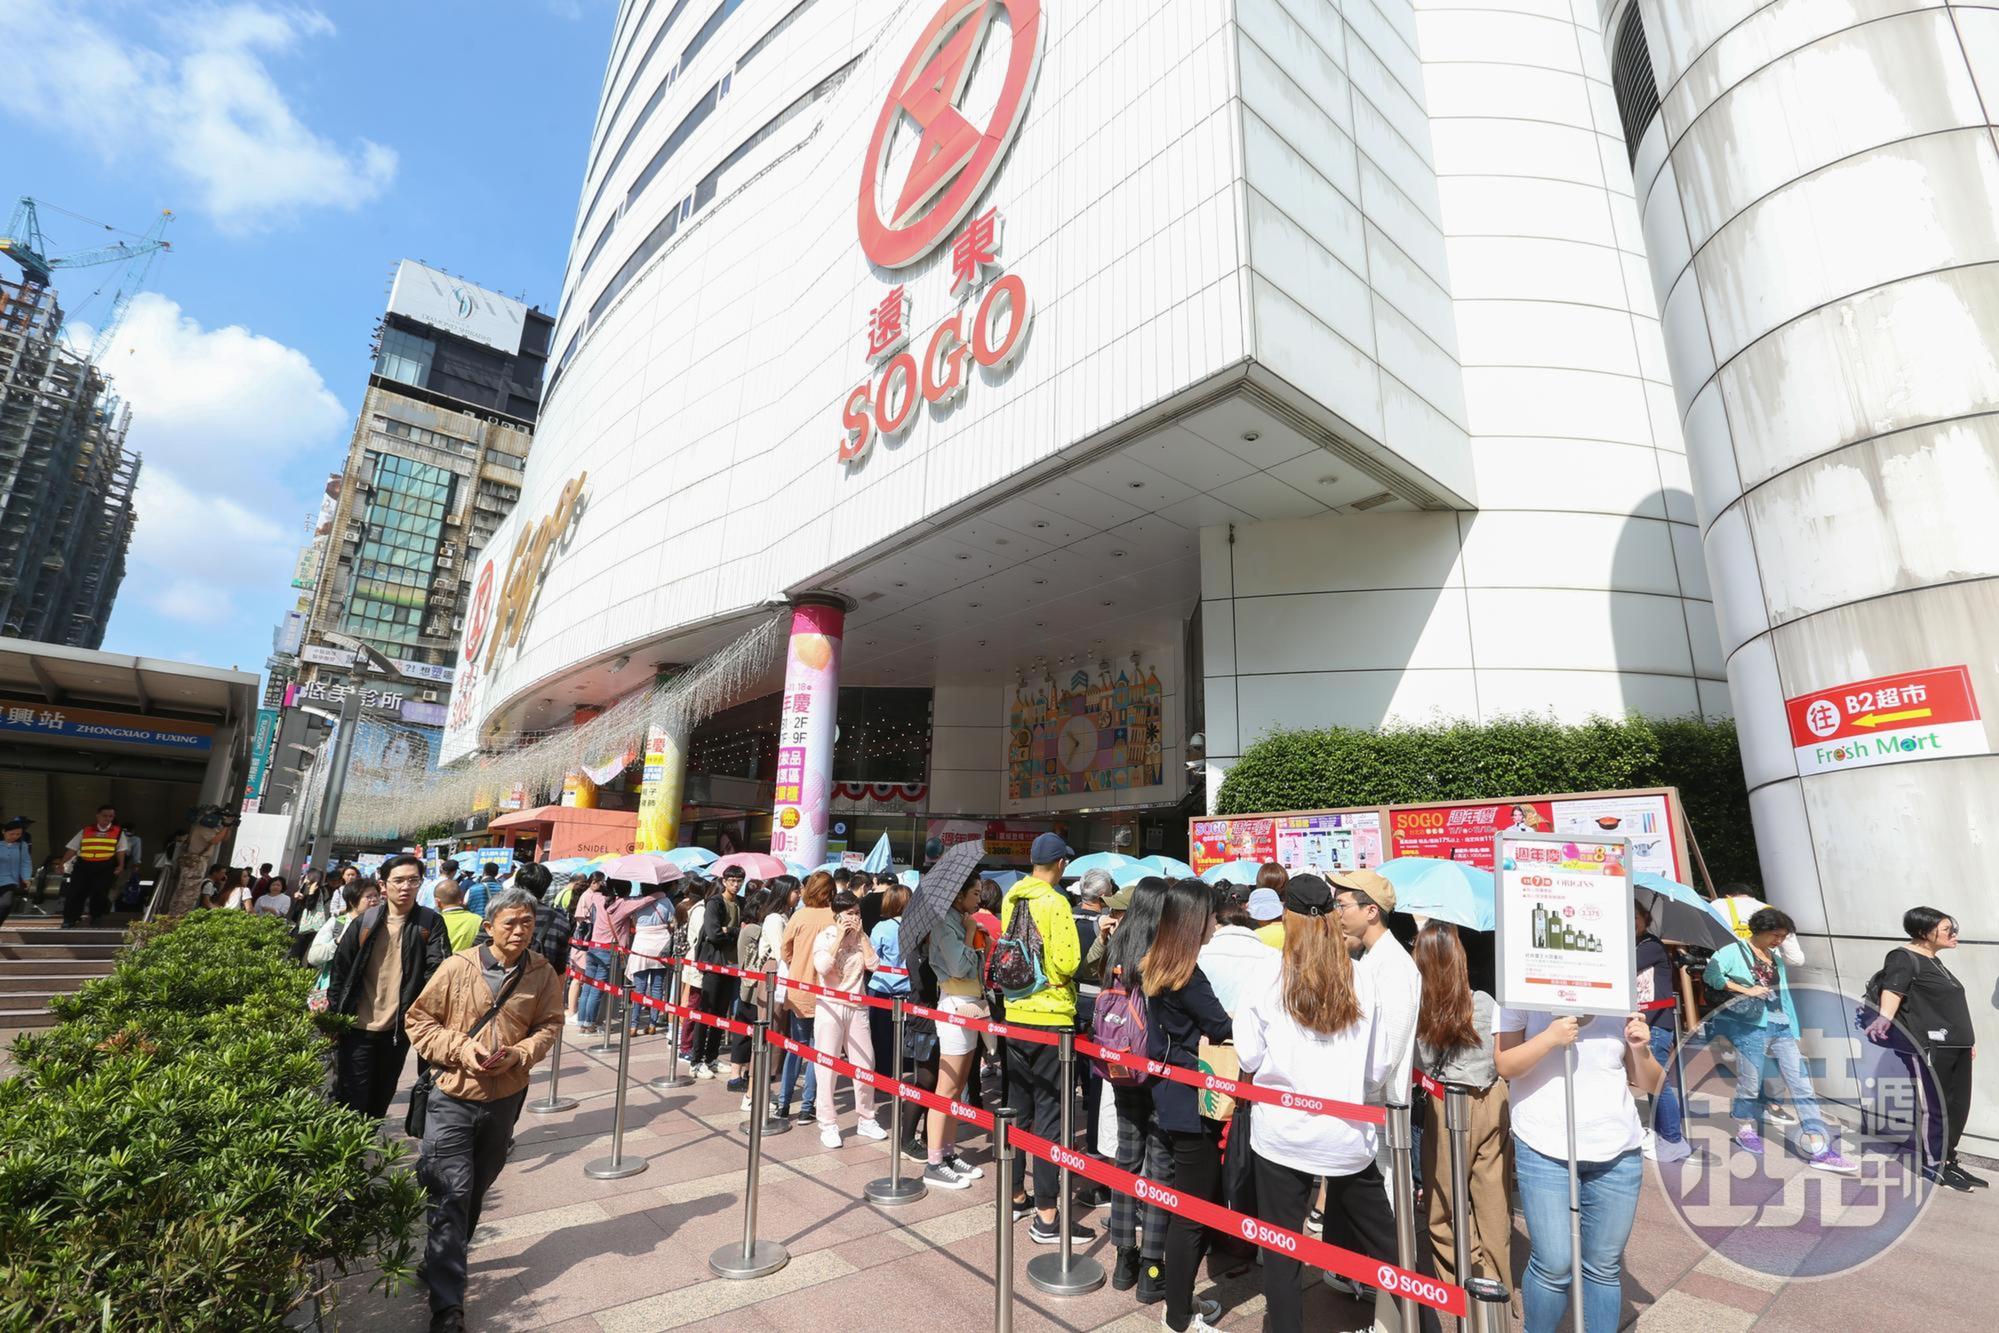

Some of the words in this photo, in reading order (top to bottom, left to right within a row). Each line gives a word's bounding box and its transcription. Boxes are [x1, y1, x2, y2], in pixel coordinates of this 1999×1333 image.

[838, 274, 1029, 465] SOGO
[0, 705, 66, 730] 興站
[1810, 705, 1836, 732] 往
[1845, 685, 1927, 715] B2超市
[76, 724, 151, 739] ZHONGXIAO
[155, 732, 198, 744] FUXING
[1816, 736, 1869, 765] Fresh
[1876, 732, 1942, 756] Mart
[1195, 822, 1228, 836] SOGO
[1397, 813, 1444, 828] SOGO
[577, 843, 609, 853] SNIDEL
[1556, 879, 1595, 888] ORIGINS
[906, 1088, 921, 1101] SOGO
[1215, 1079, 1237, 1093] SOGO
[958, 1105, 977, 1121] SOGO
[1294, 1096, 1323, 1111] SOGO
[1061, 1150, 1086, 1171] SOGO
[1148, 1184, 1179, 1209] SOGO
[1258, 1226, 1297, 1252] SOGO
[1399, 1274, 1449, 1305] SOGO
